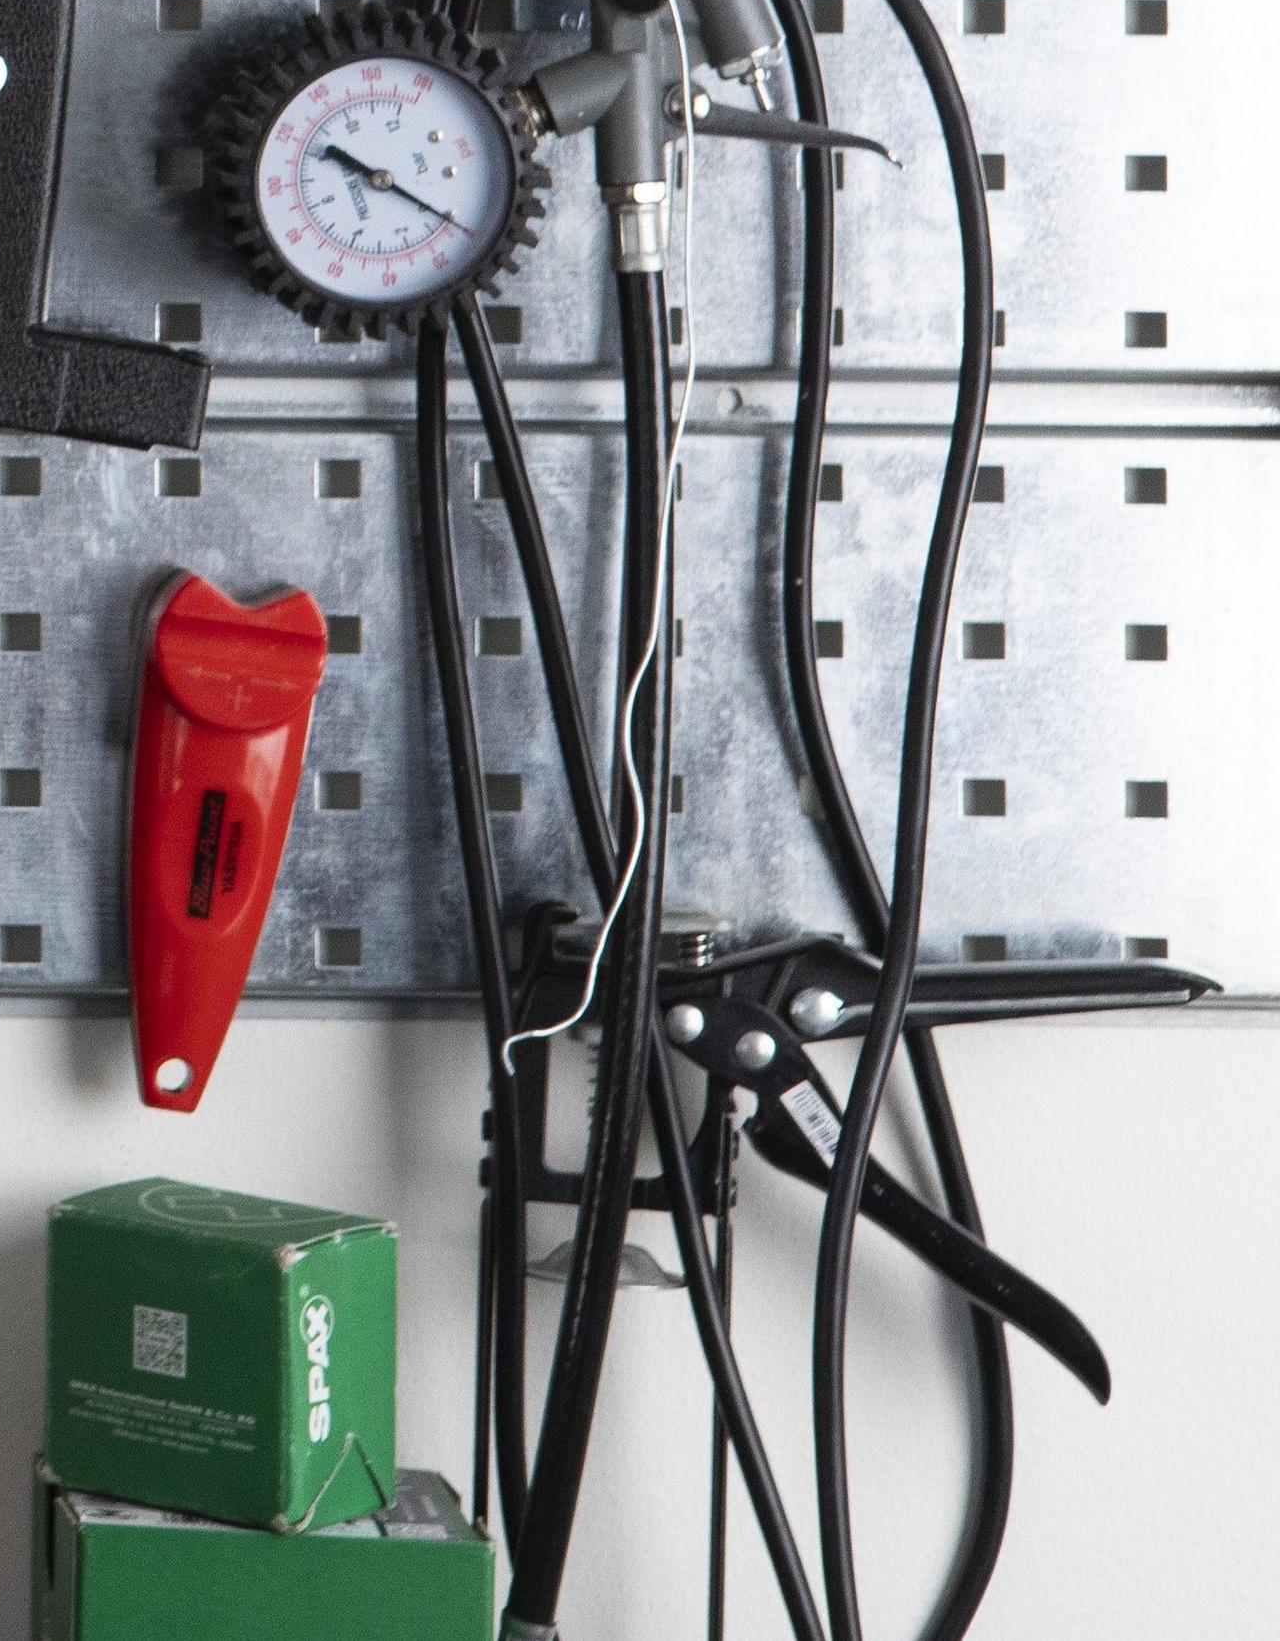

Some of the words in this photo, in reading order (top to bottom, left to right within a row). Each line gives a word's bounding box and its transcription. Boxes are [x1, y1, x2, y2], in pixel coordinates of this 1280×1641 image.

[360, 67, 382, 82] 160
[413, 73, 433, 92] 180
[307, 83, 329, 102] 140
[276, 123, 295, 143] 120
[285, 228, 302, 245] 80
[326, 261, 344, 279] 60
[381, 271, 398, 287] 40
[305, 1301, 334, 1444] SPAX
